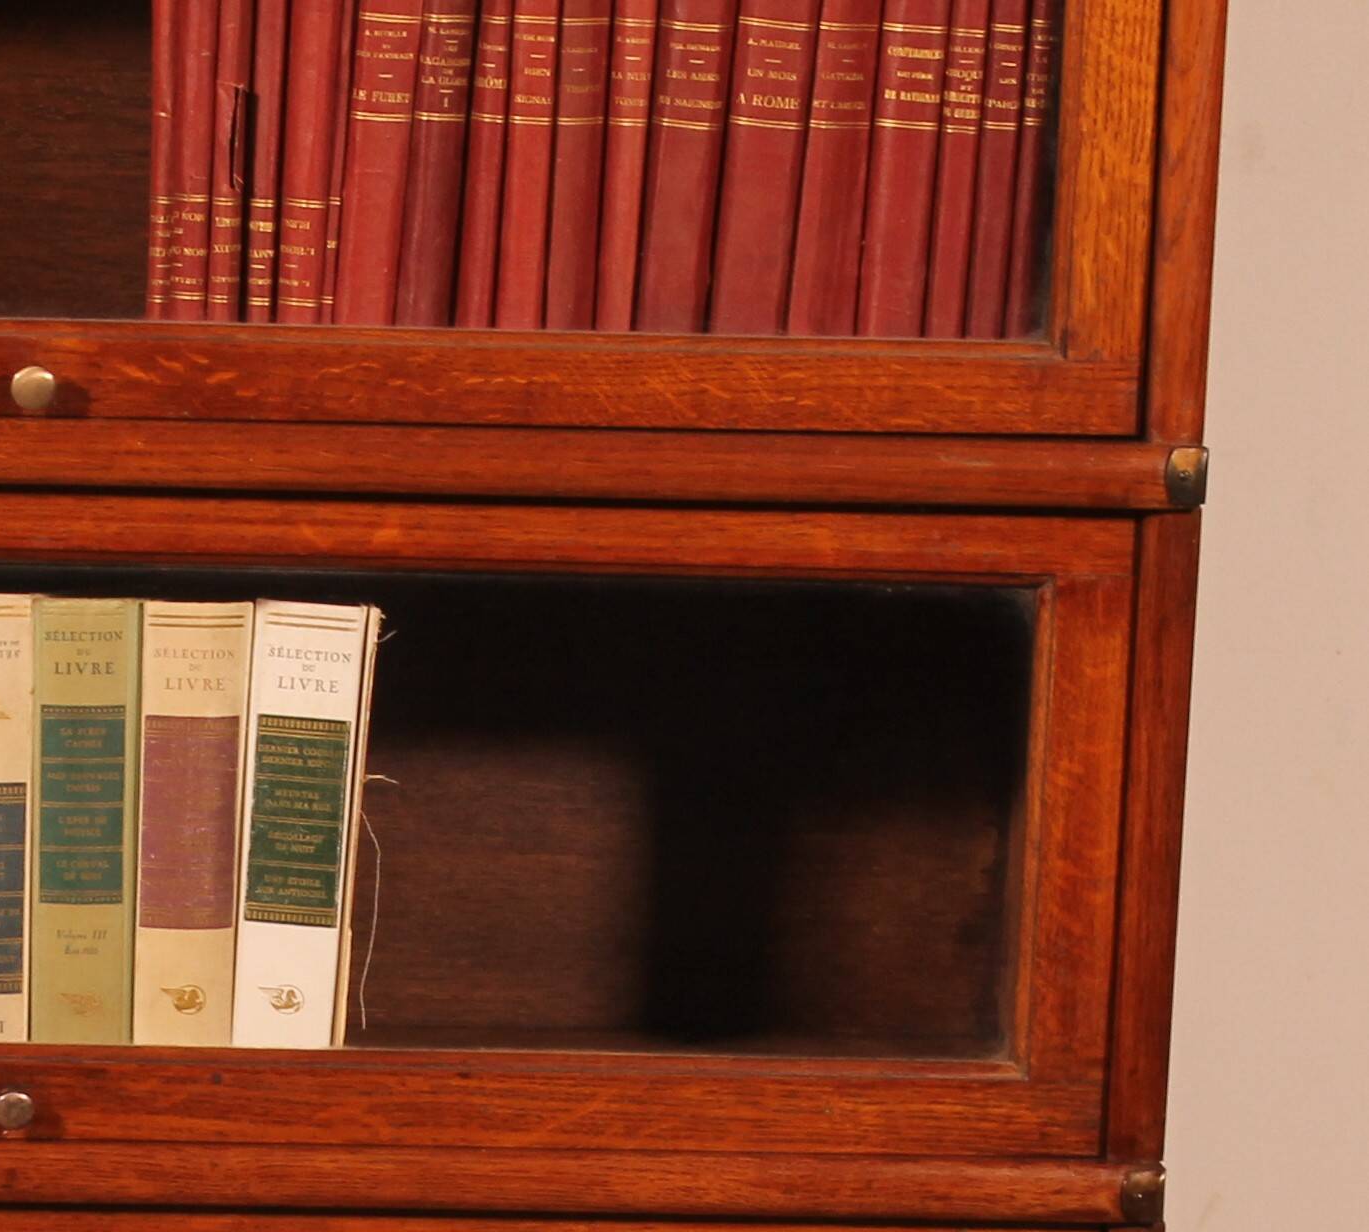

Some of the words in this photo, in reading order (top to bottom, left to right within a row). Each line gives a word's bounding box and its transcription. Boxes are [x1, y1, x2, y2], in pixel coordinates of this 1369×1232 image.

[752, 94, 800, 110] ROME
[44, 628, 124, 642] SÉLECTION
[268, 645, 353, 664] SÉLECTION
[53, 661, 116, 676] LIVRE
[164, 676, 227, 691] LIVRE
[277, 675, 341, 694] LIVRE
